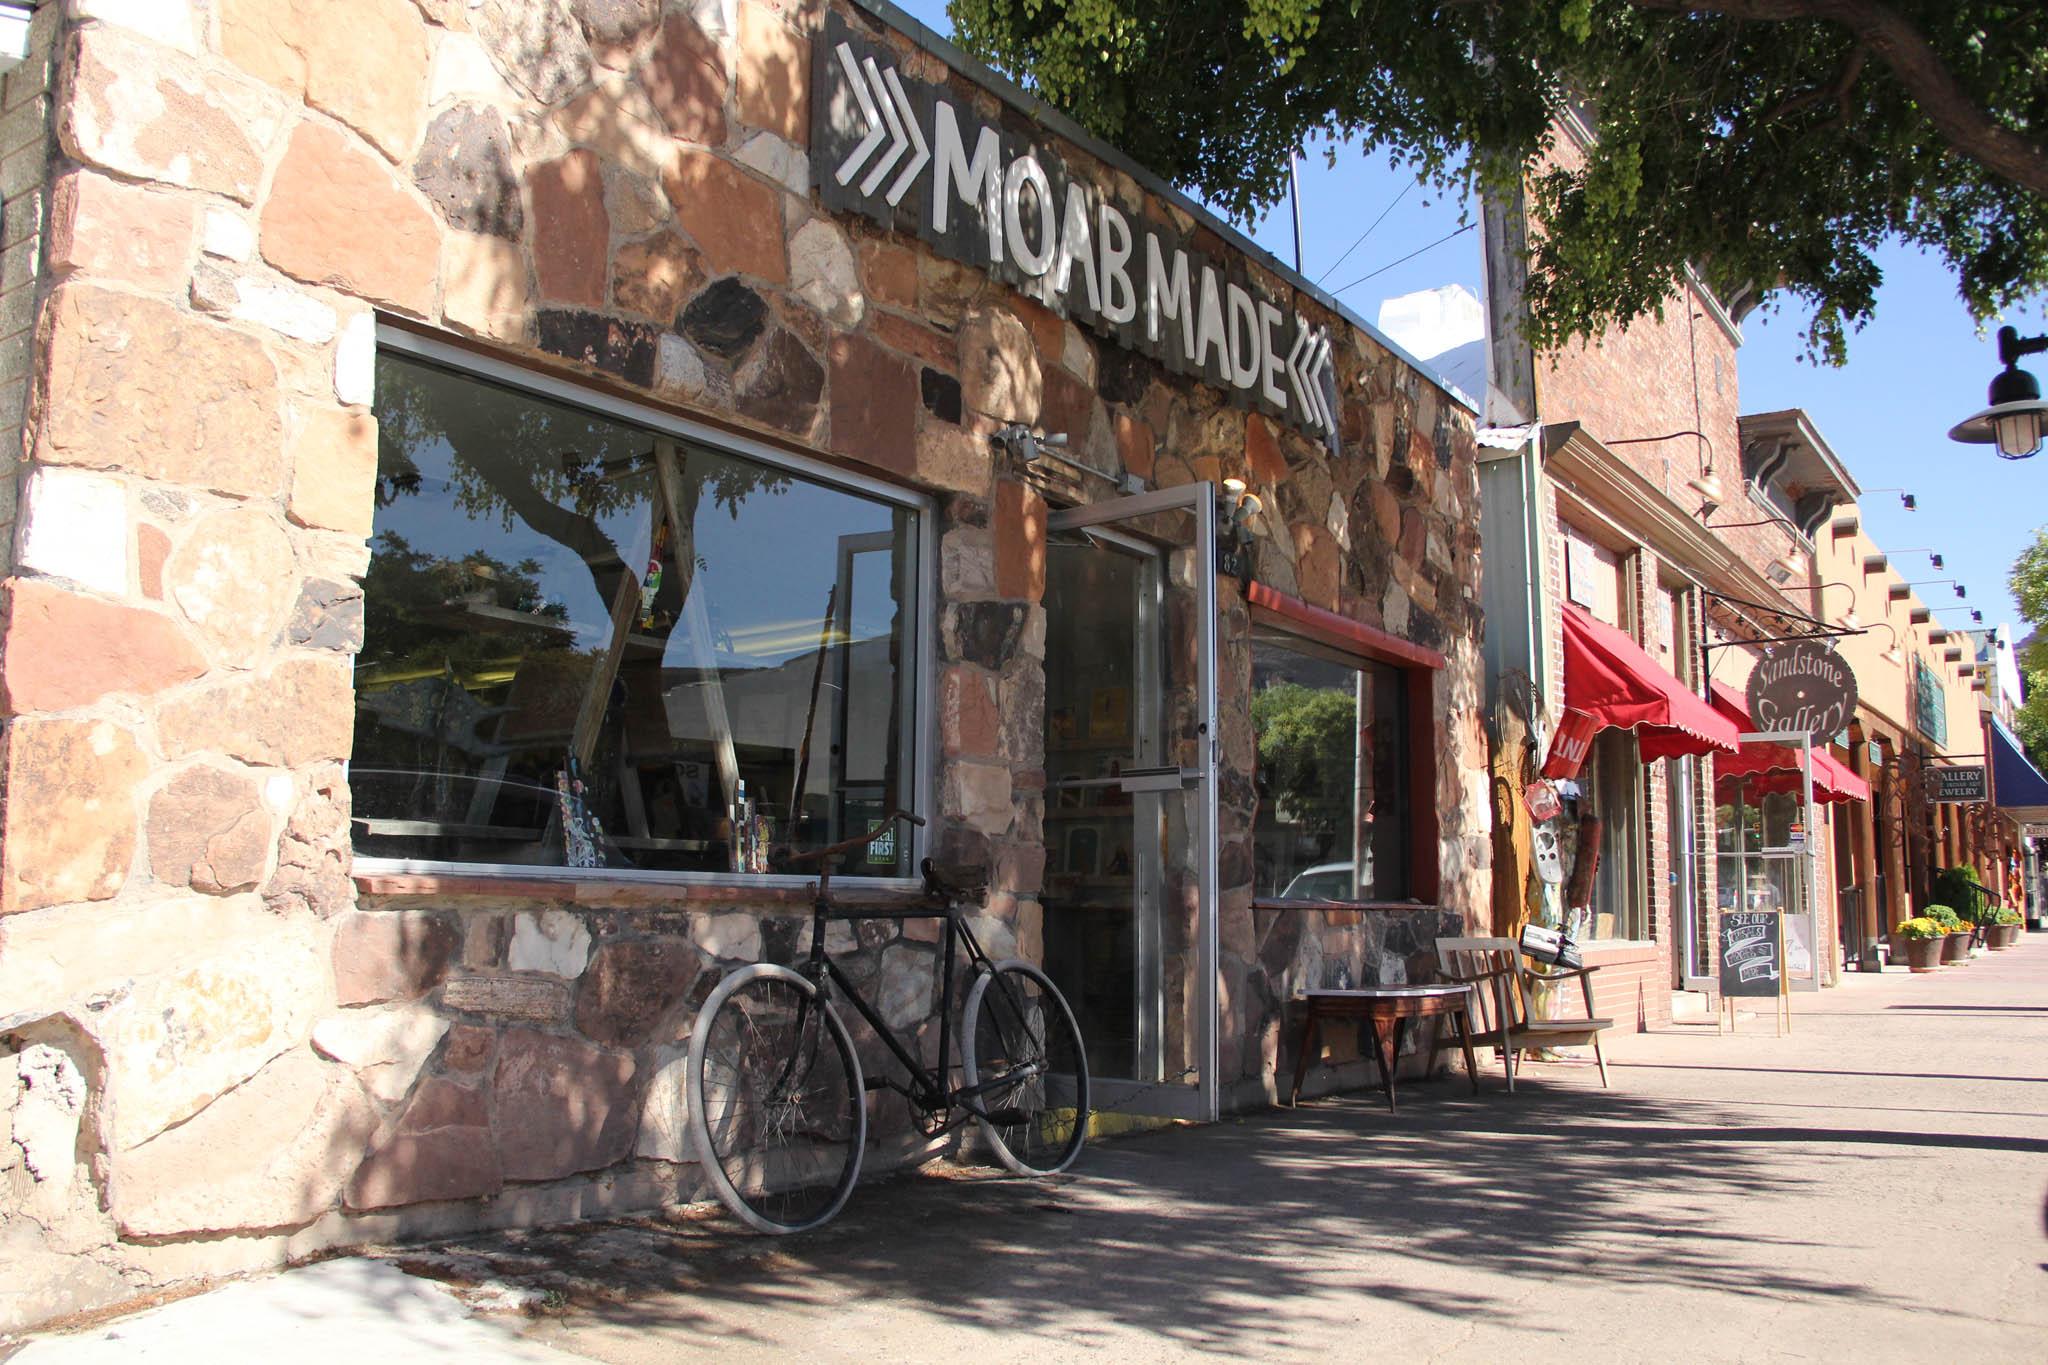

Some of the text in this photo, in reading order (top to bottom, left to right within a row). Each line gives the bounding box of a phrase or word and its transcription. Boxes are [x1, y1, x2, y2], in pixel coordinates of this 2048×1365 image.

[932, 100, 1288, 409] MOAB MADE
[1757, 645, 1842, 696] Sandstone
[1758, 692, 1847, 736] Gallery
[1553, 731, 1585, 763] TNT
[1940, 771, 1980, 781] ALLERY
[1939, 788, 1978, 796] EWELRY
[870, 841, 894, 856] FIRST
[1730, 914, 1774, 926] SEE OUR
